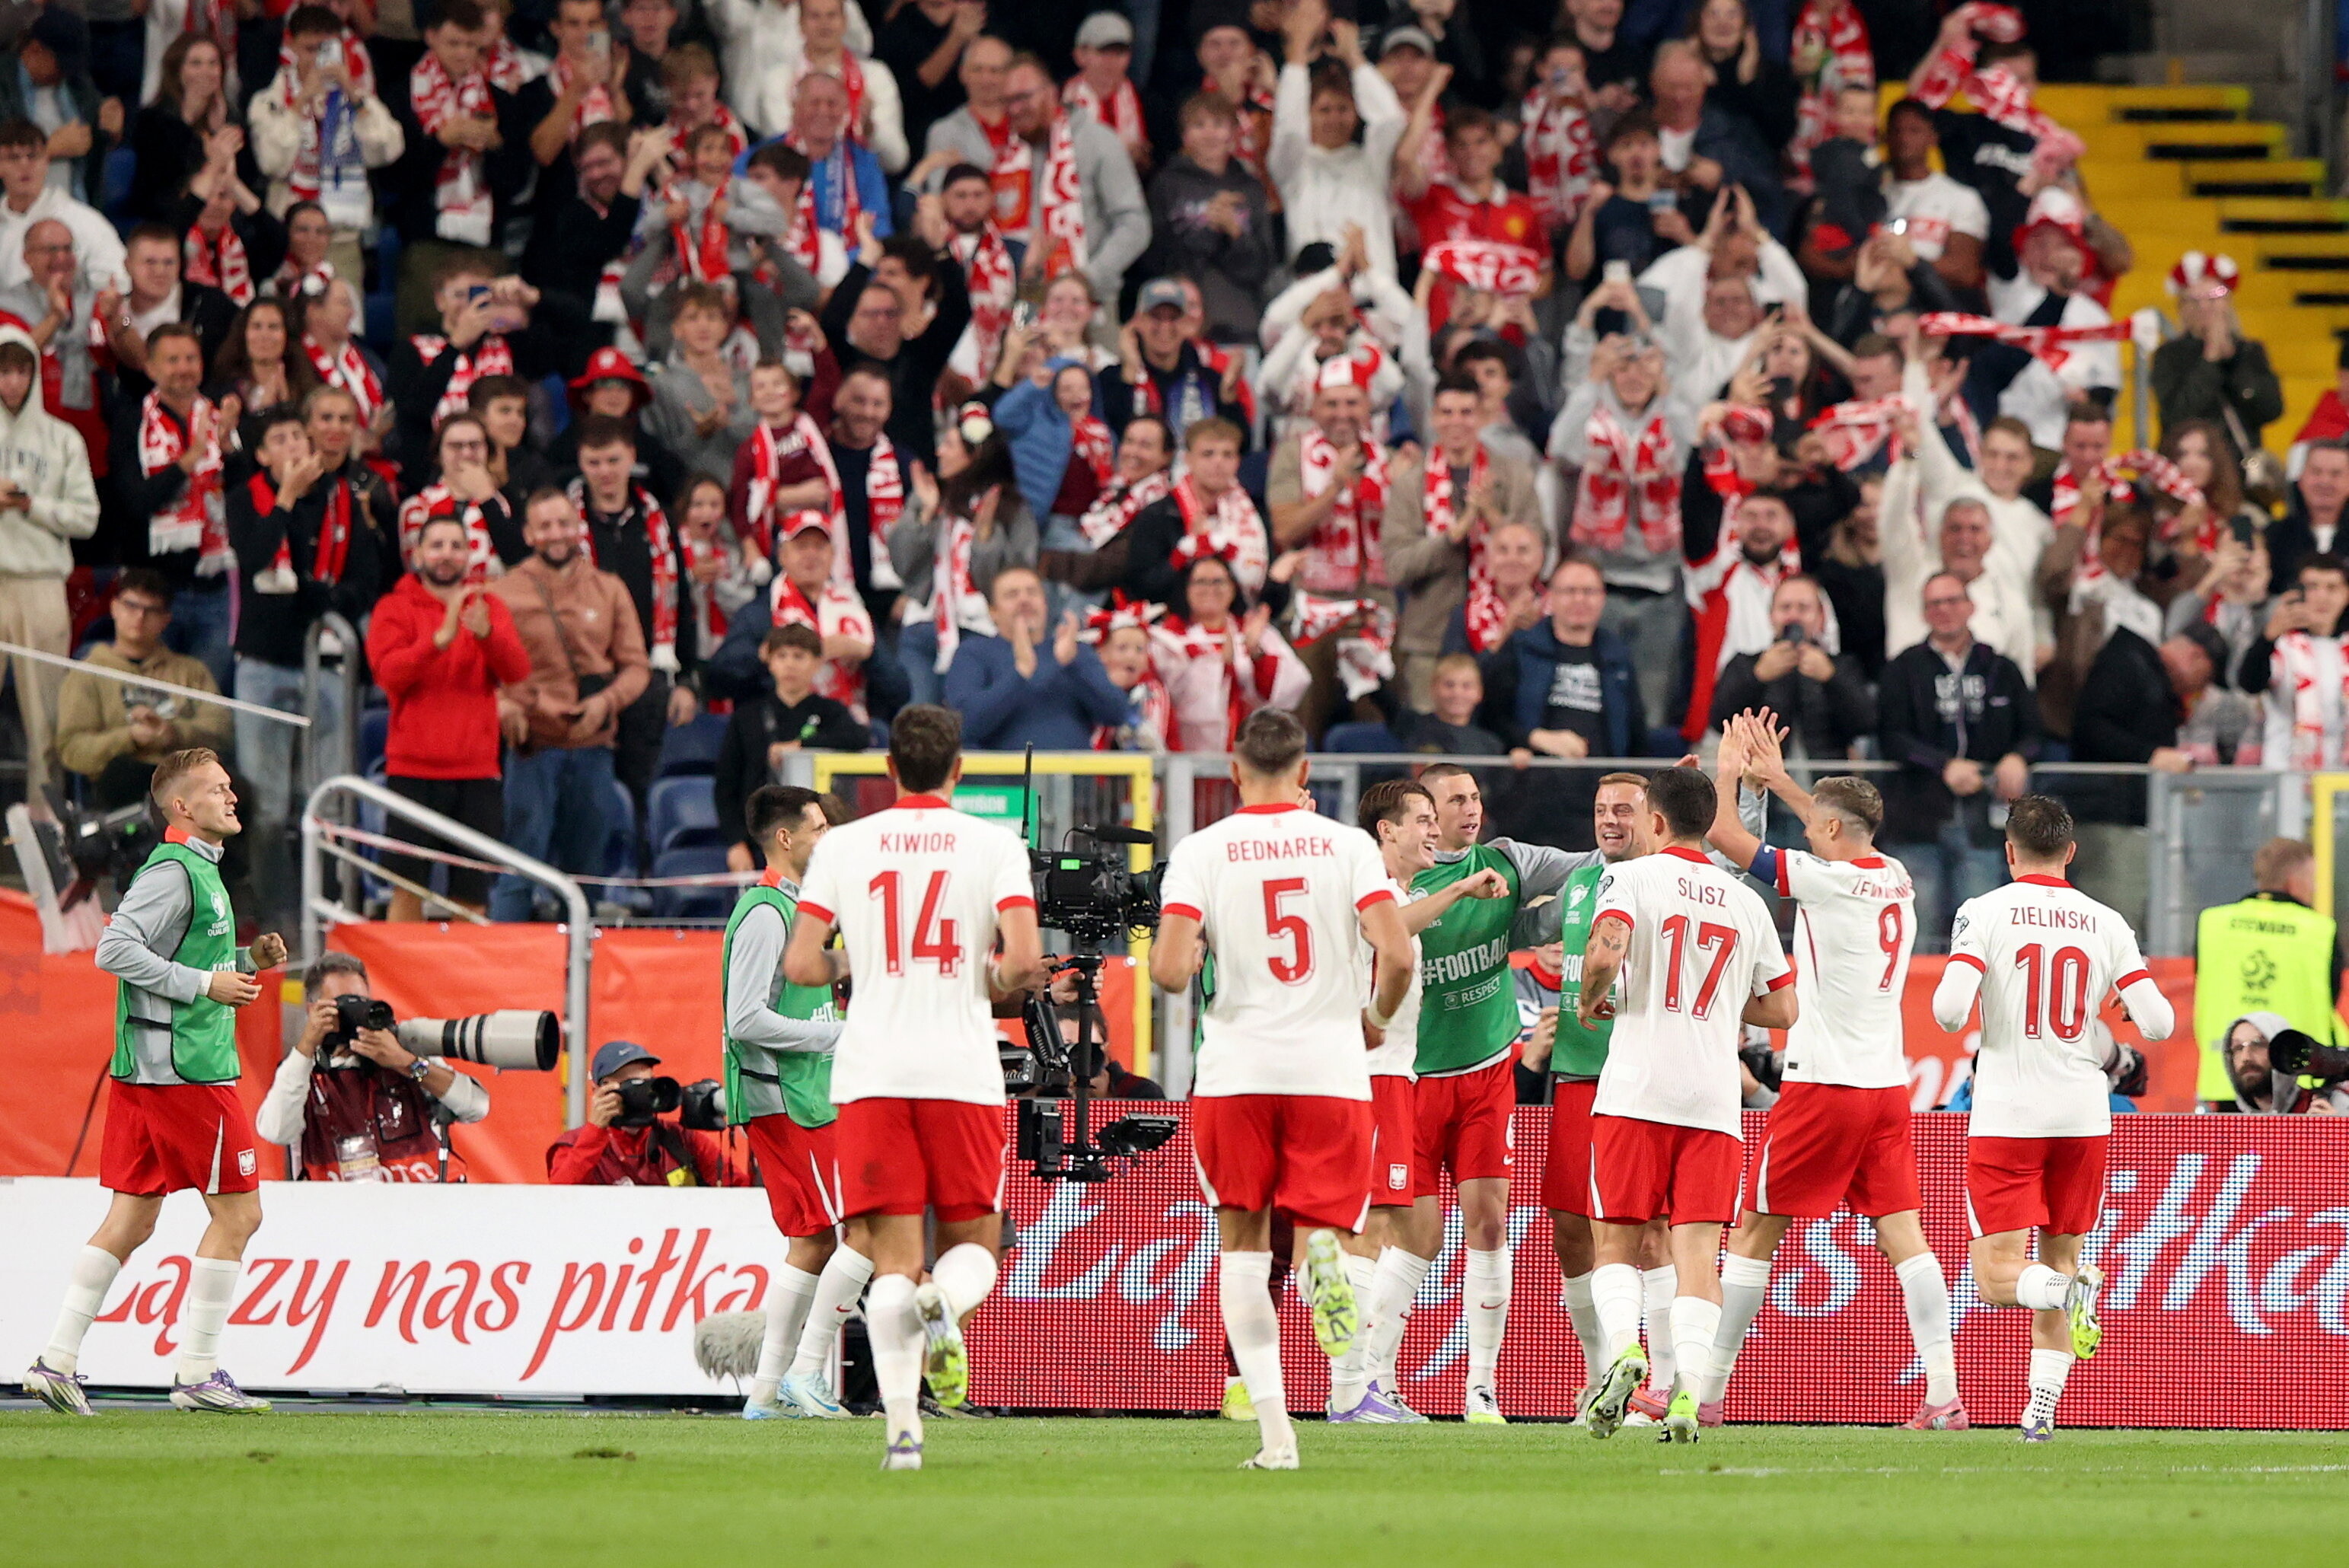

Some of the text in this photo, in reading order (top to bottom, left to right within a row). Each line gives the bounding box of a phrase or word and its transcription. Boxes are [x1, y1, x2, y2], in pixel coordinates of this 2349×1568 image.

[880, 832, 956, 853] KIWIOR
[1226, 837, 1335, 862] BEDNAREK
[869, 870, 964, 978] 14
[1262, 877, 1316, 987] 5
[1678, 877, 1727, 908] SLISZ
[2010, 906, 2096, 934] ZIELIŃSKI
[1461, 975, 1501, 1004] RESPECT
[1661, 914, 1740, 1021] 17
[1878, 903, 1905, 993] 9
[2015, 942, 2092, 1044] 10
[363, 1260, 532, 1345] nas
[518, 1228, 770, 1382] piłka
